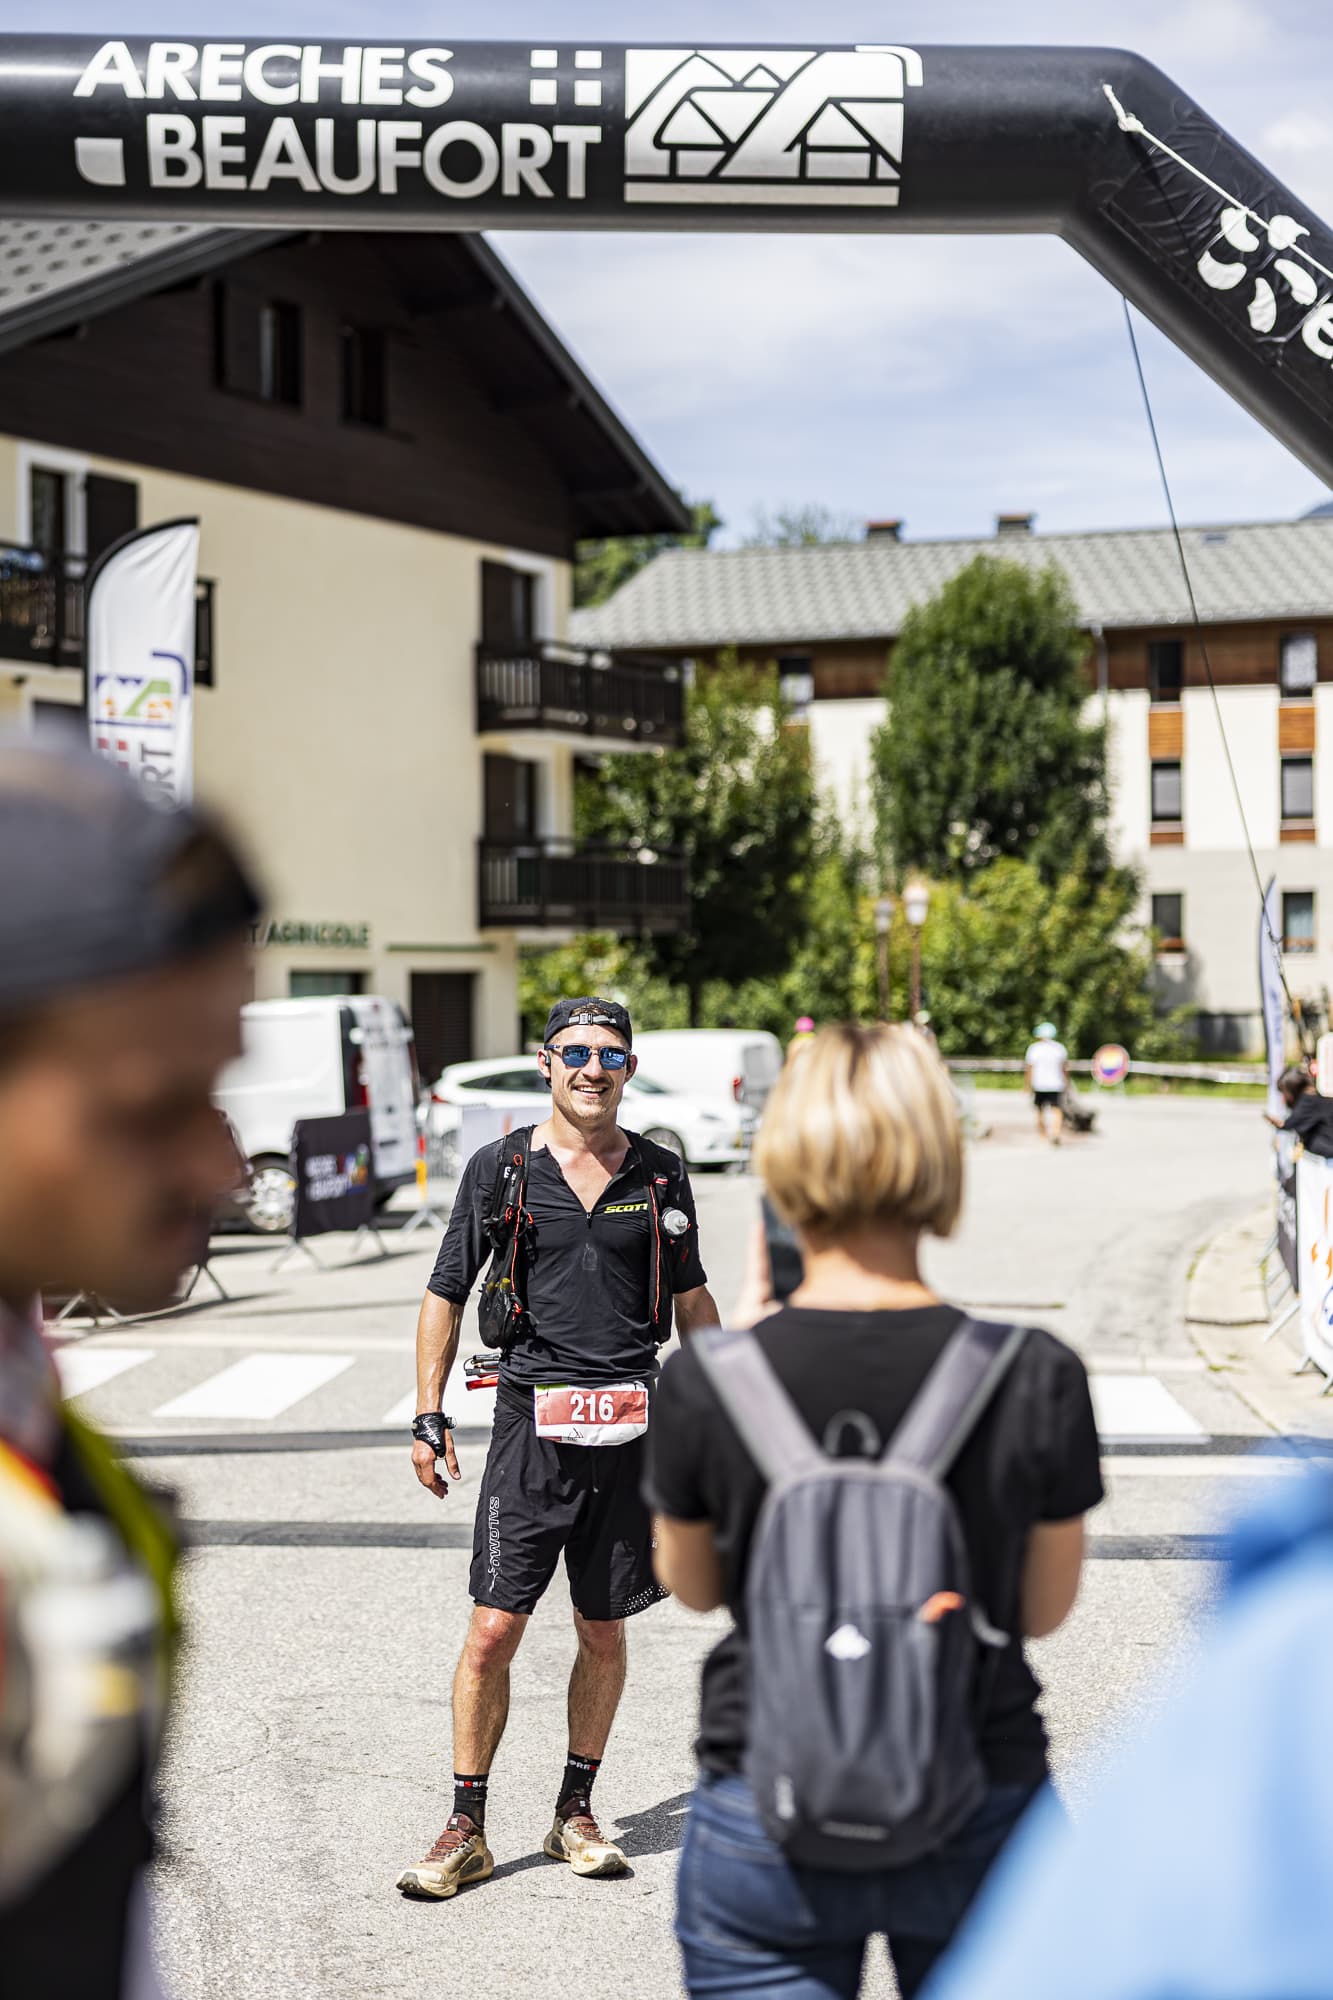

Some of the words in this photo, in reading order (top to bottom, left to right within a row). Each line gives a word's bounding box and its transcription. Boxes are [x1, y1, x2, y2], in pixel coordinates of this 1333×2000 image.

[73, 41, 455, 107] ARECHES
[146, 113, 602, 199] BEAUFORT
[604, 1203, 649, 1214] SCOTT
[570, 1393, 614, 1422] 216
